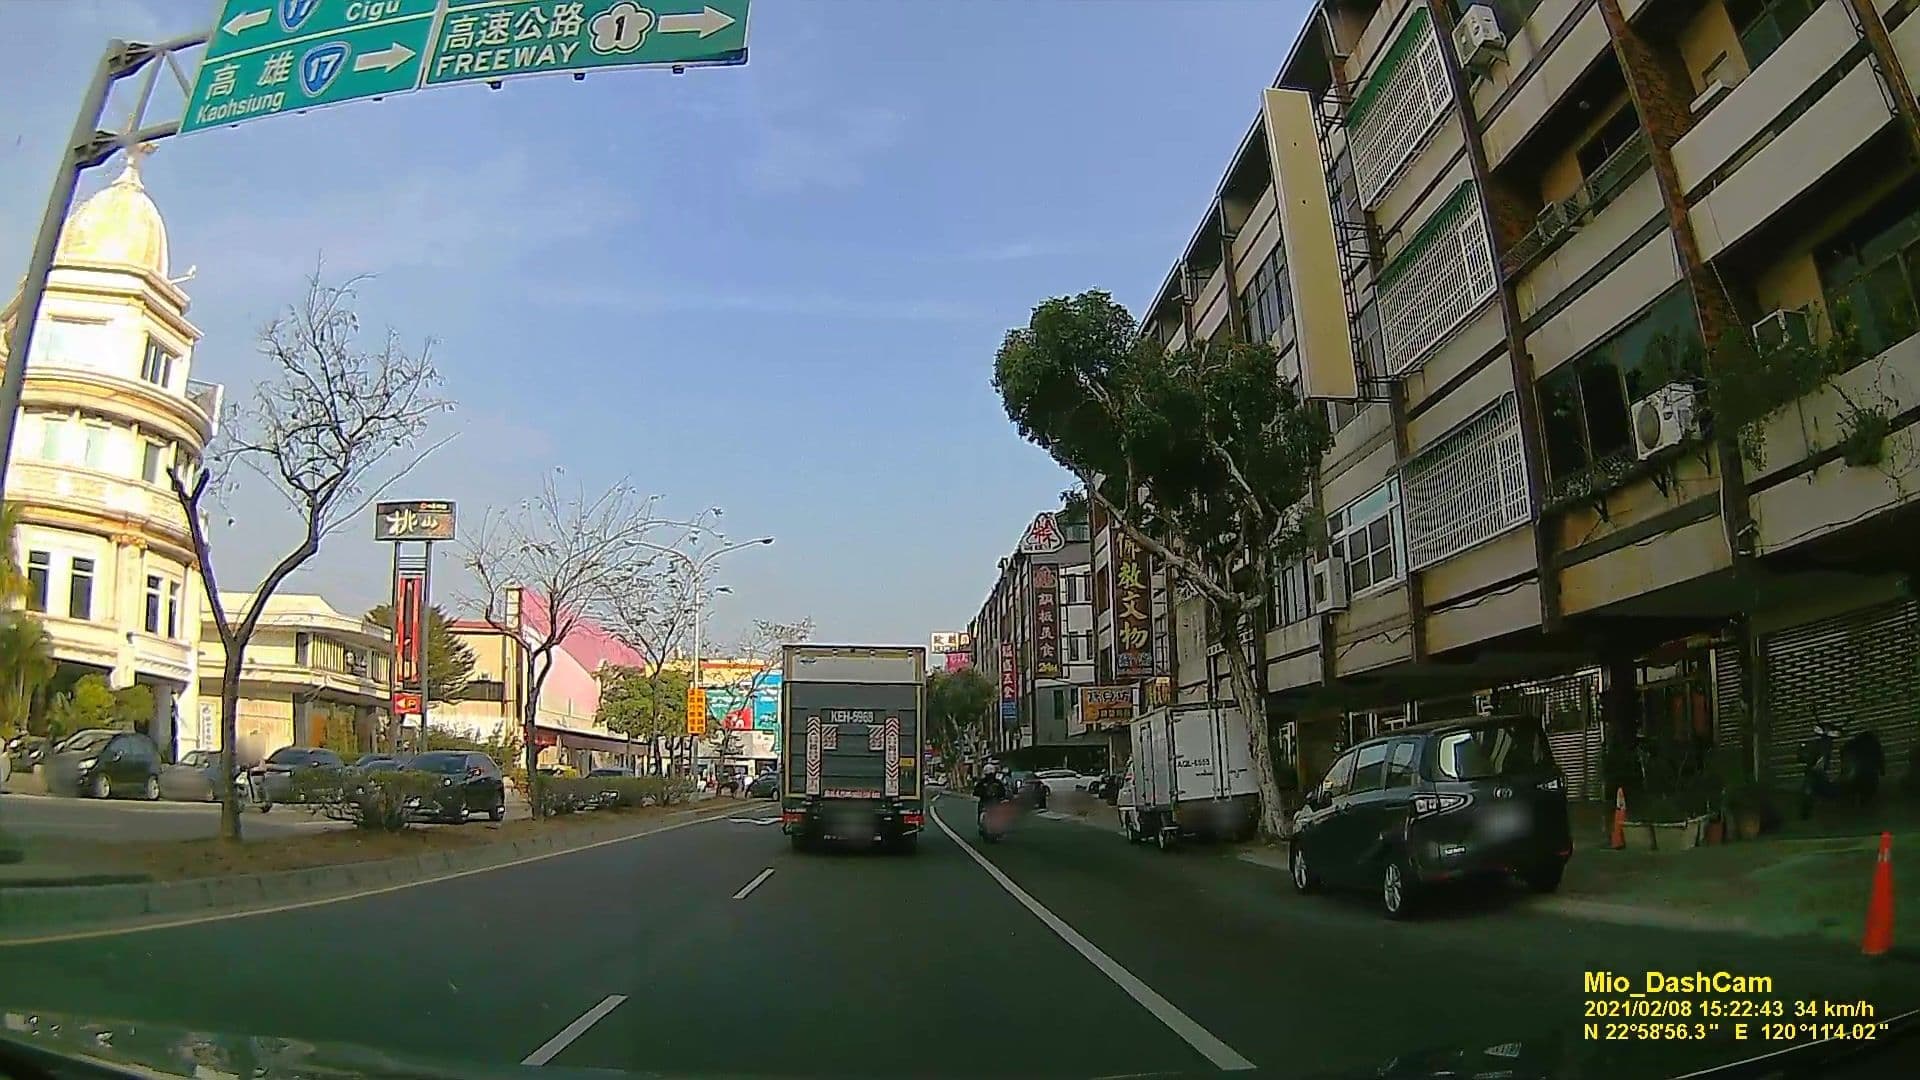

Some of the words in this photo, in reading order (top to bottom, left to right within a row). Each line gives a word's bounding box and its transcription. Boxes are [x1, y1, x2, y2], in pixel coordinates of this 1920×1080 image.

[346, 0, 400, 22] Cigu
[442, 2, 586, 52] 高速公路
[614, 15, 626, 41] 1
[207, 51, 294, 100] 高雄
[309, 54, 338, 82] 17
[436, 41, 580, 77] FREEWAY
[196, 91, 285, 124] Kaohsiung
